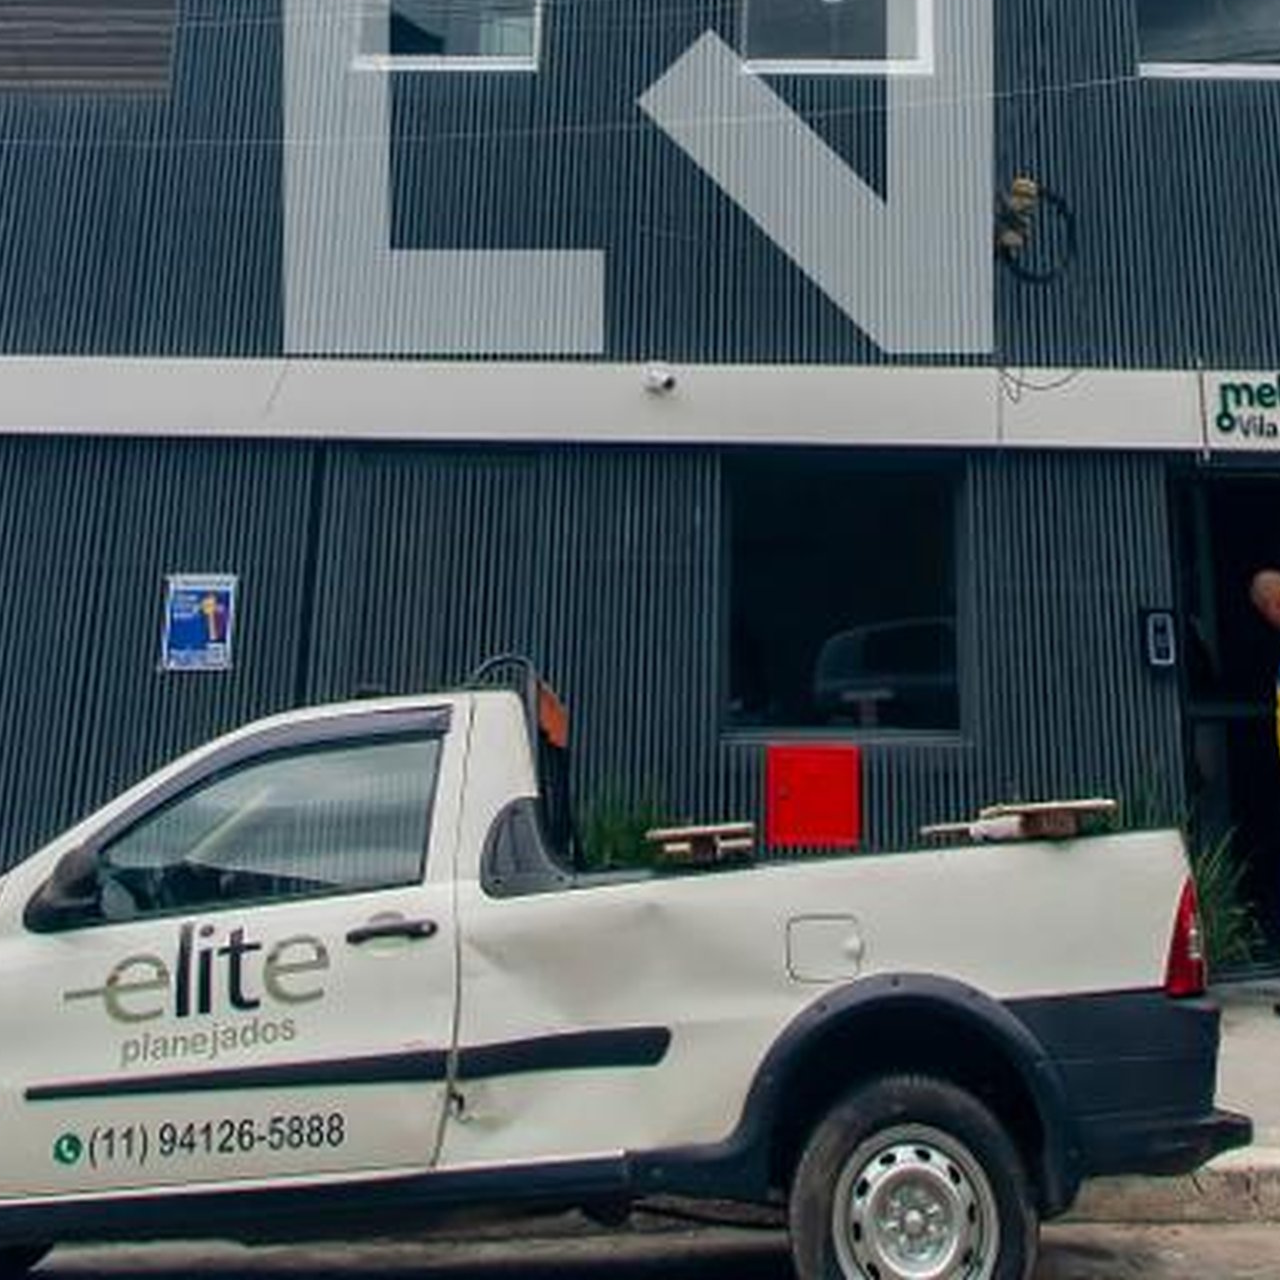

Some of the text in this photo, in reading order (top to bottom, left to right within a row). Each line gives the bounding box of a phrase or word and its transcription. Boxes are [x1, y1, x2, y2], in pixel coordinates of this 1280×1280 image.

[1238, 415, 1279, 439] Vila
[64, 920, 330, 1024] elite
[120, 1015, 297, 1068] planejados
[88, 1111, 346, 1171] (11) 94126-5888
